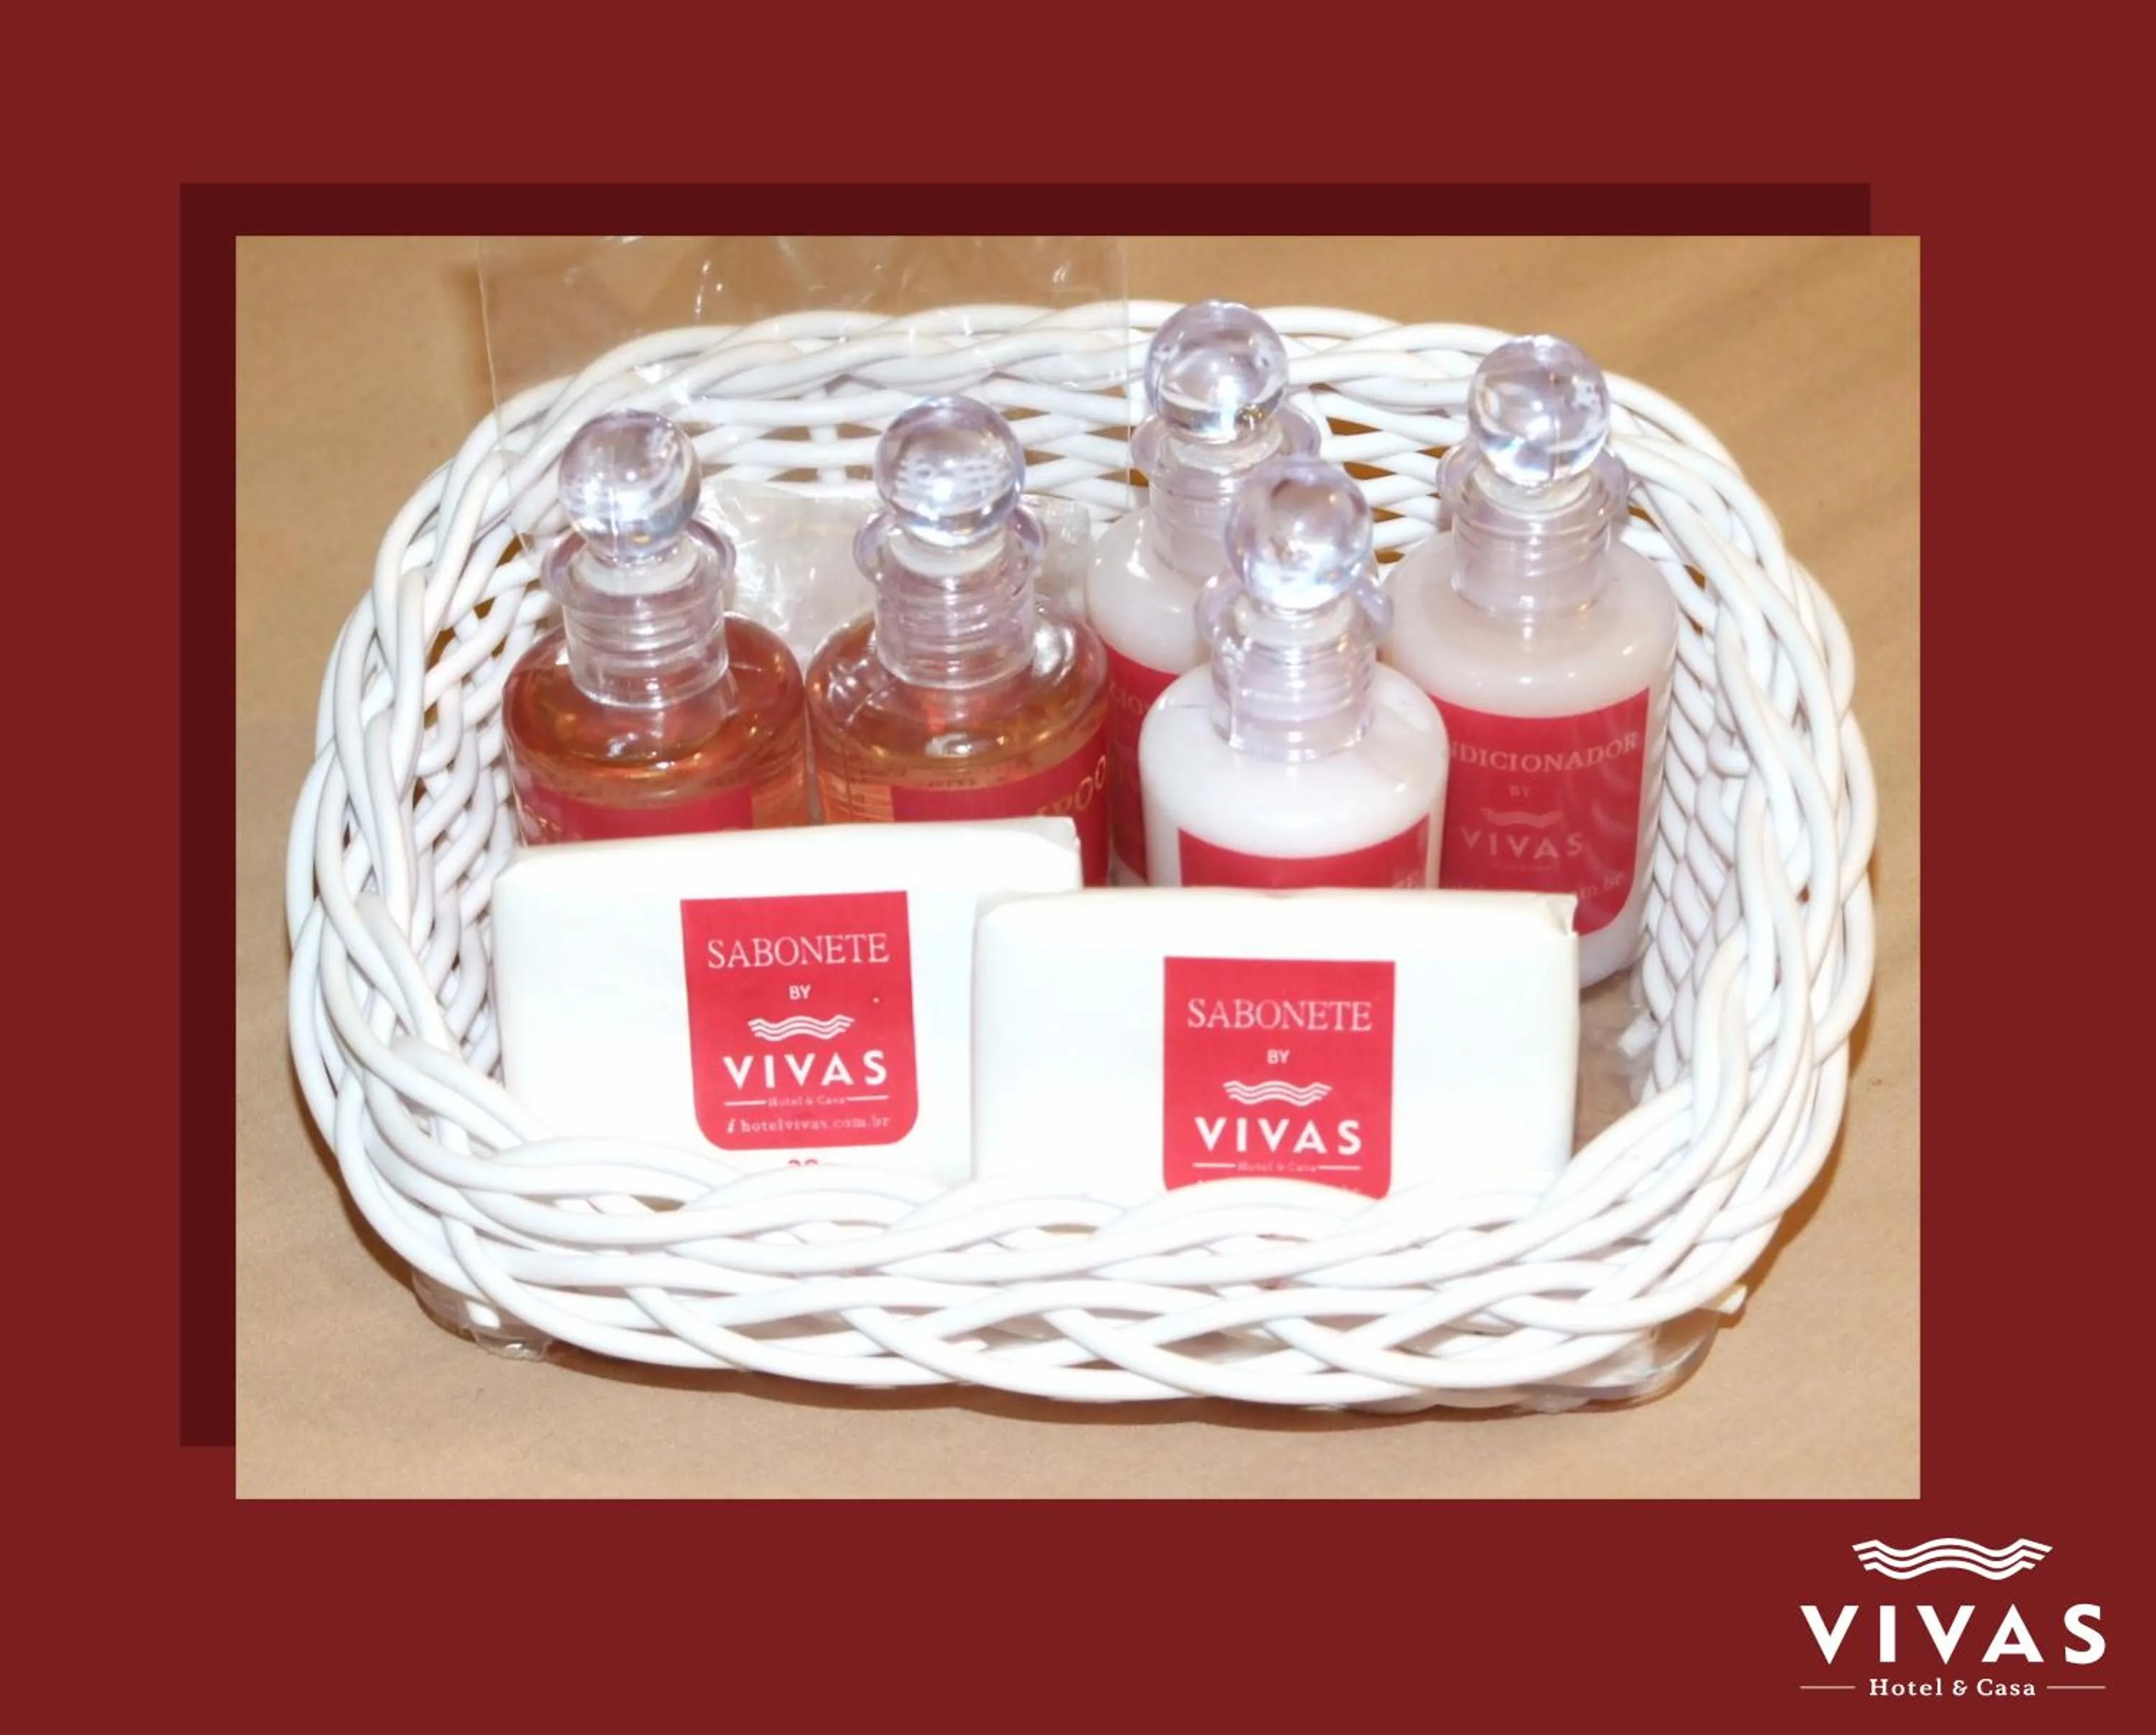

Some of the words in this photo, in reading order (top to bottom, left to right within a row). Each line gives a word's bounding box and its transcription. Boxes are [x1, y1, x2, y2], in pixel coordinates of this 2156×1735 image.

[1036, 754, 1106, 816] POO
[1509, 785, 1530, 797] BY
[1462, 826, 1583, 858] VIVAS
[707, 933, 890, 969] SABONETE
[789, 985, 811, 1000] BY
[1187, 998, 1373, 1031] SABONETE
[723, 1049, 888, 1090] VIVAS
[1267, 1049, 1290, 1064] BY
[1194, 1116, 1362, 1155] VIVAS
